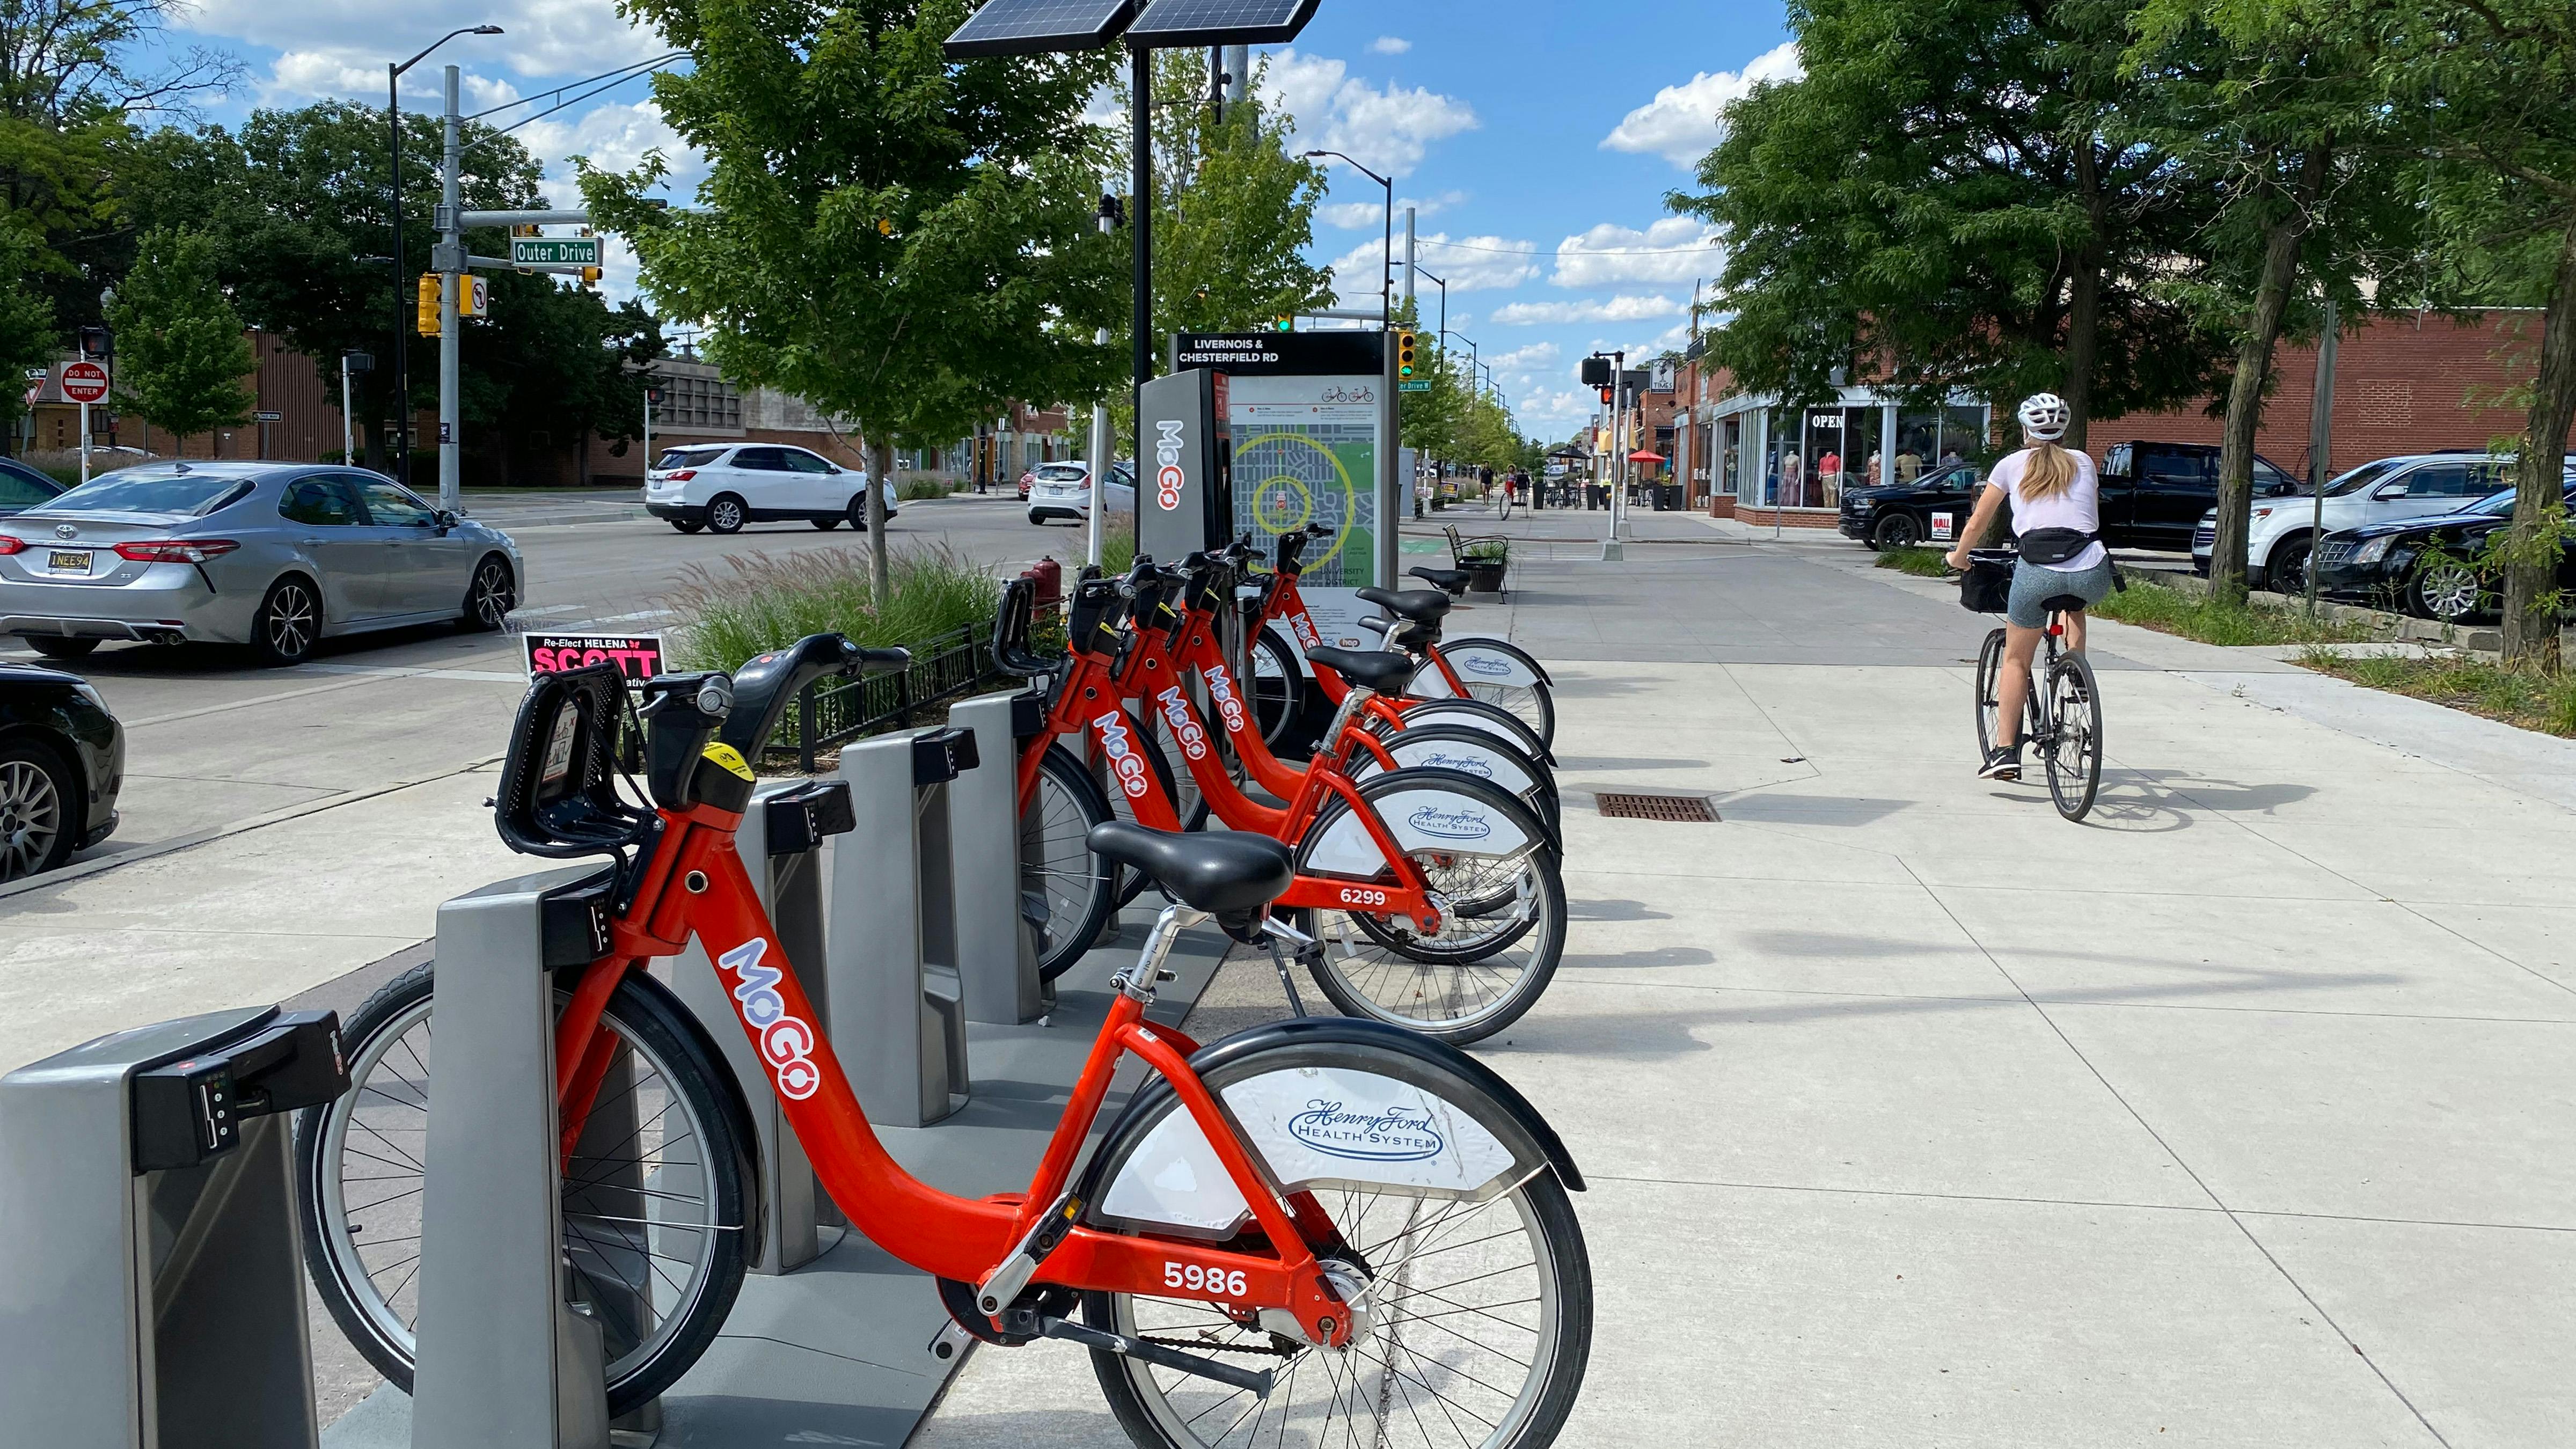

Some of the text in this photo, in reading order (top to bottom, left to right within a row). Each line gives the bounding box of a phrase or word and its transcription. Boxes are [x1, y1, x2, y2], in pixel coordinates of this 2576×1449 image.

[517, 243, 594, 261] Outer Drive
[1194, 339, 1263, 349] LIVERNOIS &
[1179, 353, 1279, 362] CHESTERFIELD RD
[1812, 415, 1844, 428] OPEN
[1934, 518, 1950, 528] HALL
[544, 638, 627, 649] Re-Elect HELENA
[1342, 639, 1358, 647] hap
[534, 648, 657, 677] SCOTT
[1428, 753, 1488, 769] Henry Ford
[1417, 806, 1485, 825] Henry Ford
[1413, 819, 1487, 832] HEALTH SYSTEM
[1340, 888, 1386, 906] 6299
[1305, 1099, 1433, 1134] Henry Ford
[1298, 1125, 1436, 1148] HEALTH SYSTEM
[1164, 1261, 1247, 1297] 5986
